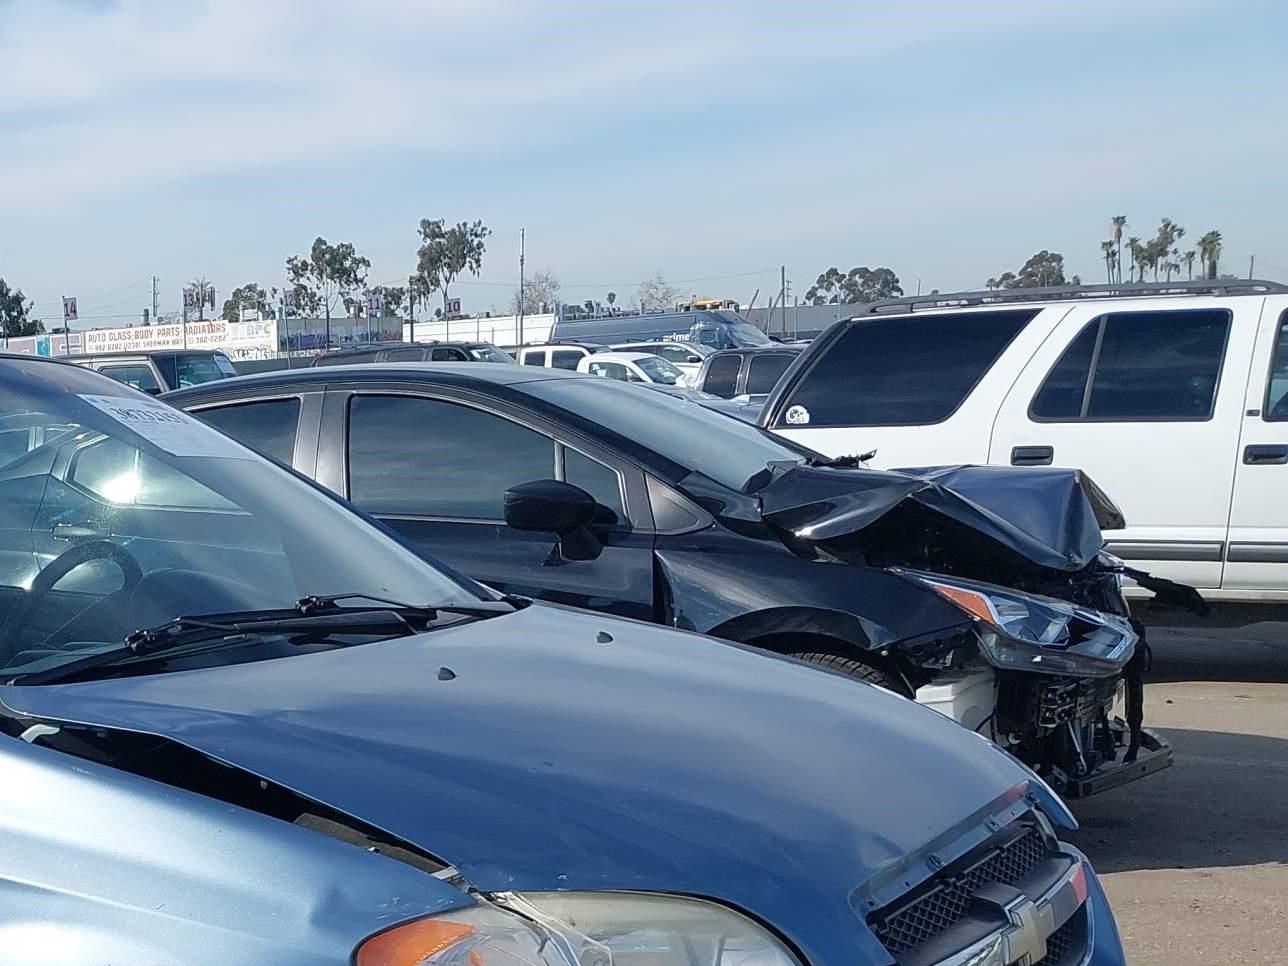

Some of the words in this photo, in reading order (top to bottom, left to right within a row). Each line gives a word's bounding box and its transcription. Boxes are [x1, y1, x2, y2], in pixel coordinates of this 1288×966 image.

[64, 301, 77, 317] 14
[368, 298, 380, 310] 11
[447, 301, 460, 312] 10
[88, 333, 106, 343] AUTO
